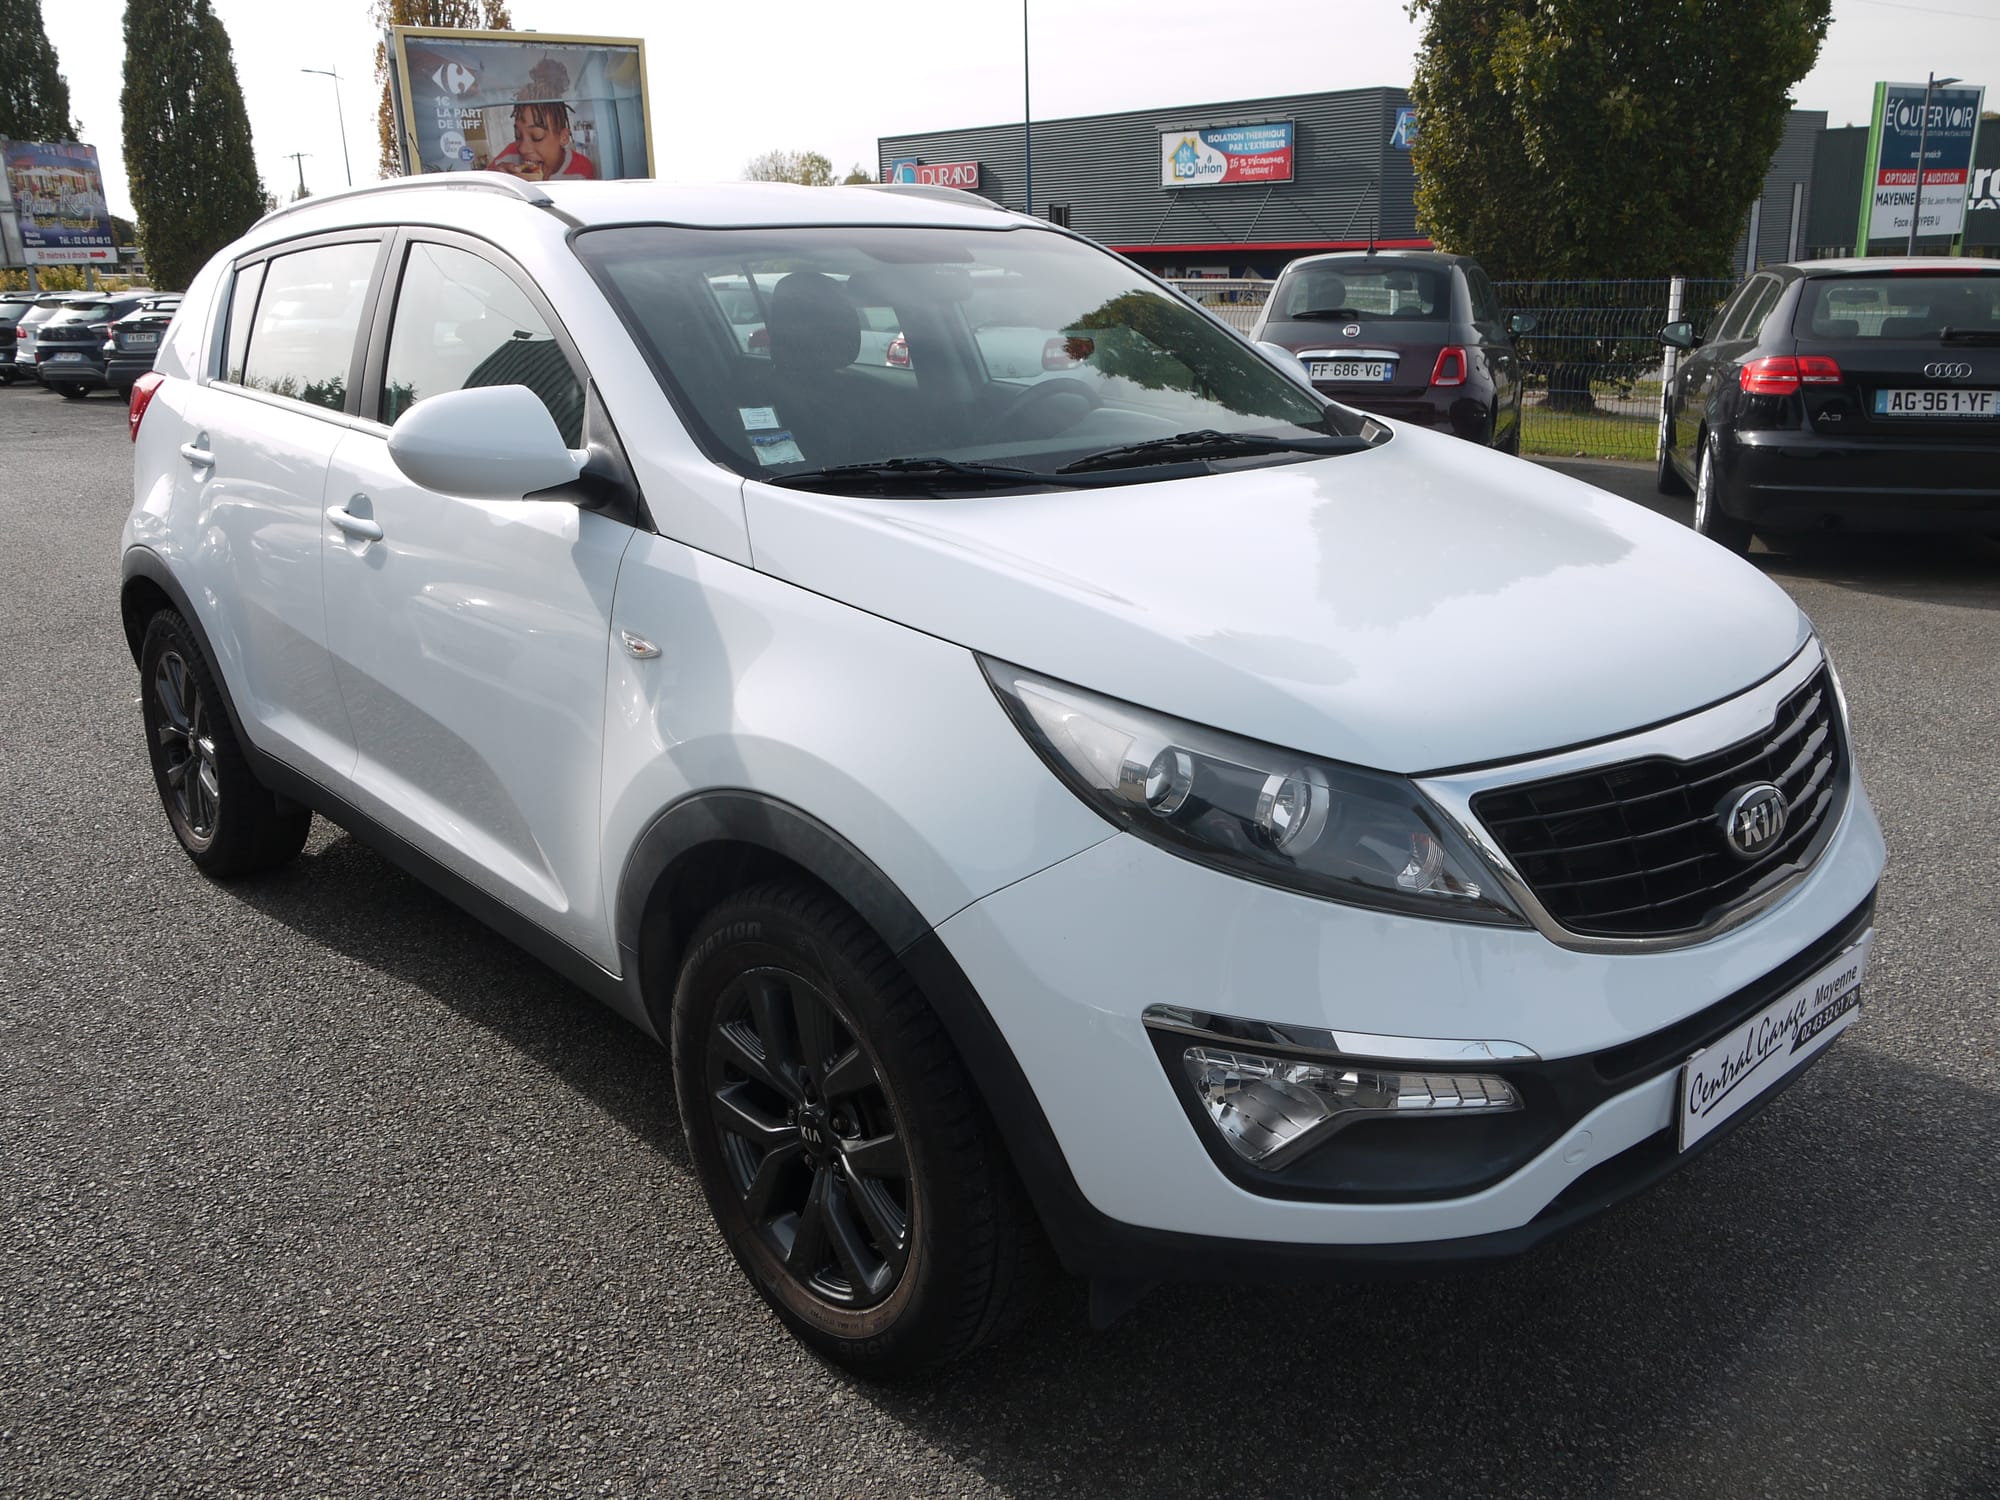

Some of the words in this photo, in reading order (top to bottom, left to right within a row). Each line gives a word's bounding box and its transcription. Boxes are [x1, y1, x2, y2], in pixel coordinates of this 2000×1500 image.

[436, 108, 453, 118] LA
[454, 109, 482, 118] PART
[1945, 106, 1974, 128] VOIR
[438, 120, 453, 129] DE
[1208, 133, 1244, 143] ISOLATION
[1245, 129, 1286, 140] THERMIQUE
[1229, 142, 1243, 151] PAR
[1244, 139, 1286, 151] L'EXTÉRIEUR
[921, 165, 977, 185] DURAND
[1885, 173, 1916, 184] OPTIQUE
[1927, 172, 1960, 183] AUDITION
[1875, 191, 1916, 206] MAYENNE
[1894, 216, 1907, 228] Face
[1311, 363, 1382, 377] FF-686-VG
[1891, 391, 1992, 411] AG-961-YF
[1818, 411, 1842, 422] A3
[1739, 797, 1784, 847] KIA
[1690, 1027, 1753, 1115] Central
[1757, 998, 1807, 1057] Garage
[1814, 965, 1858, 1007] Mayenne
[801, 1125, 822, 1143] KIA
